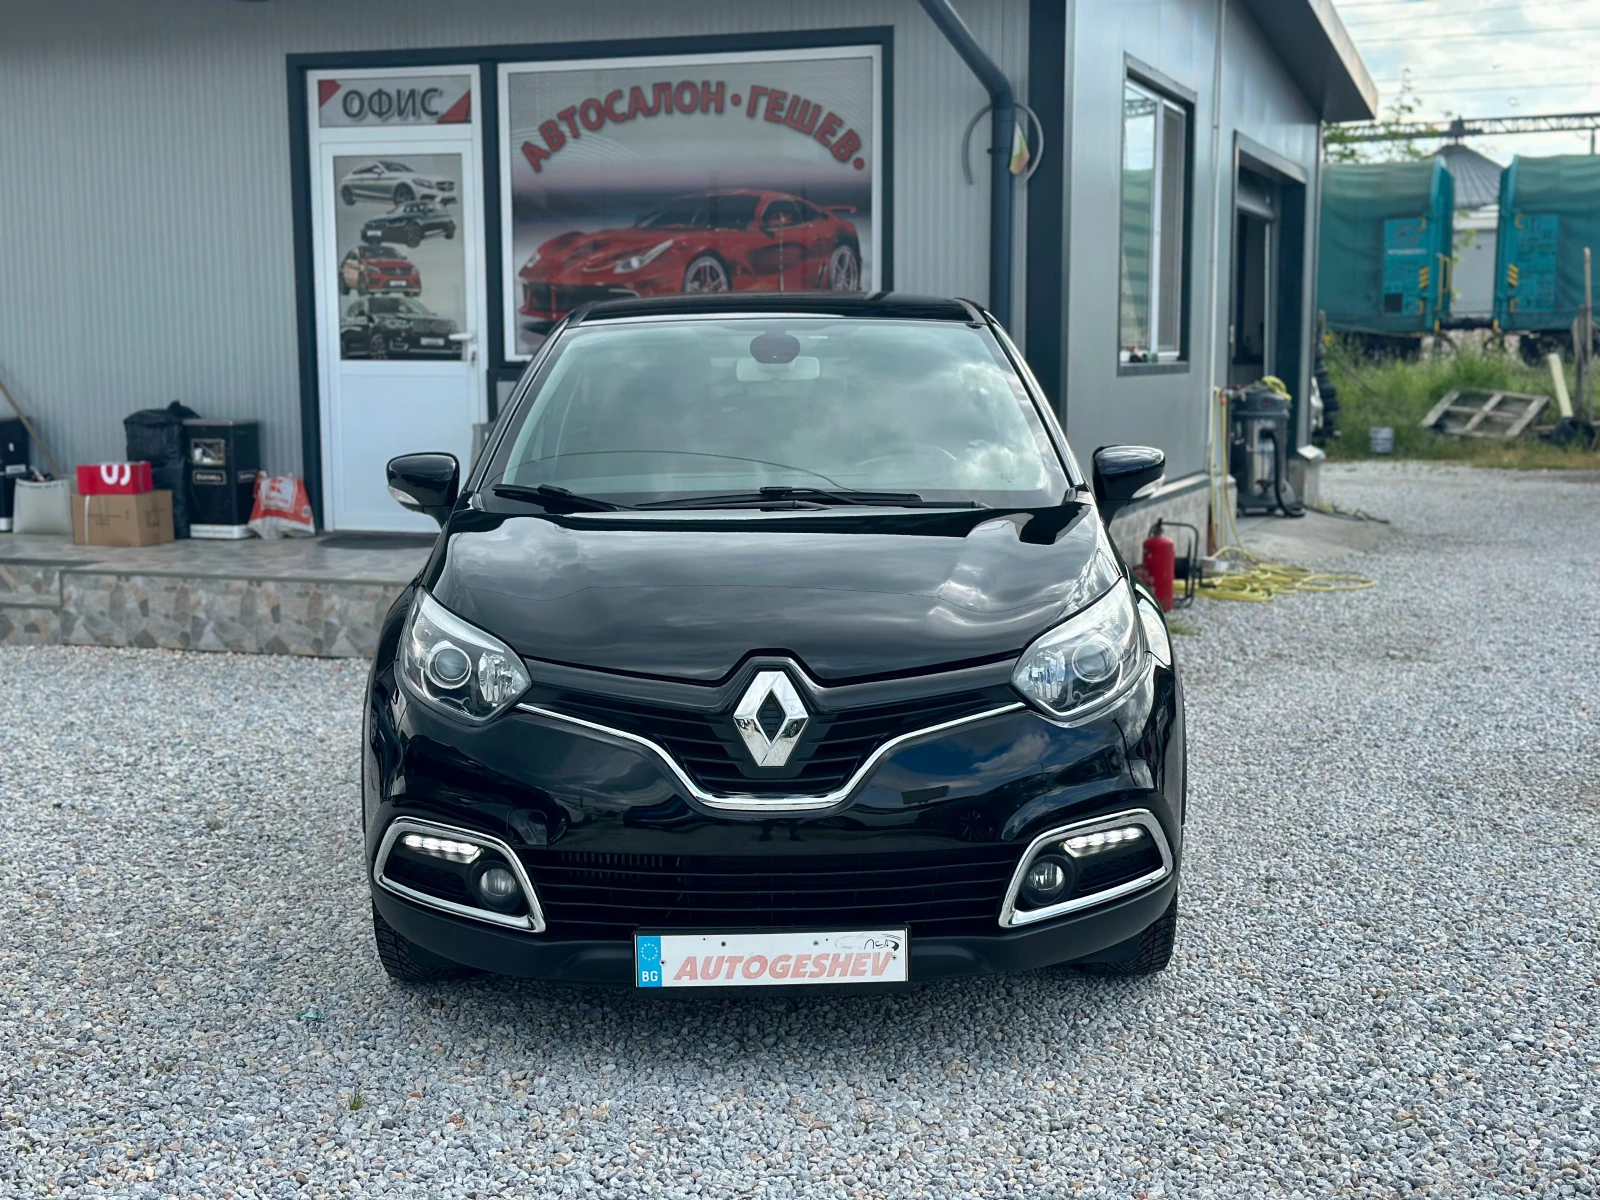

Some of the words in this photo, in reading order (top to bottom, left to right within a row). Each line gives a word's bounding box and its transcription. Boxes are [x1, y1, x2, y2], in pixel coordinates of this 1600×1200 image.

[341, 87, 442, 119] ОФИС
[520, 80, 726, 174] АВТОСАЛОН
[641, 970, 659, 983] BG
[673, 951, 893, 981] AUTOGESHEV
